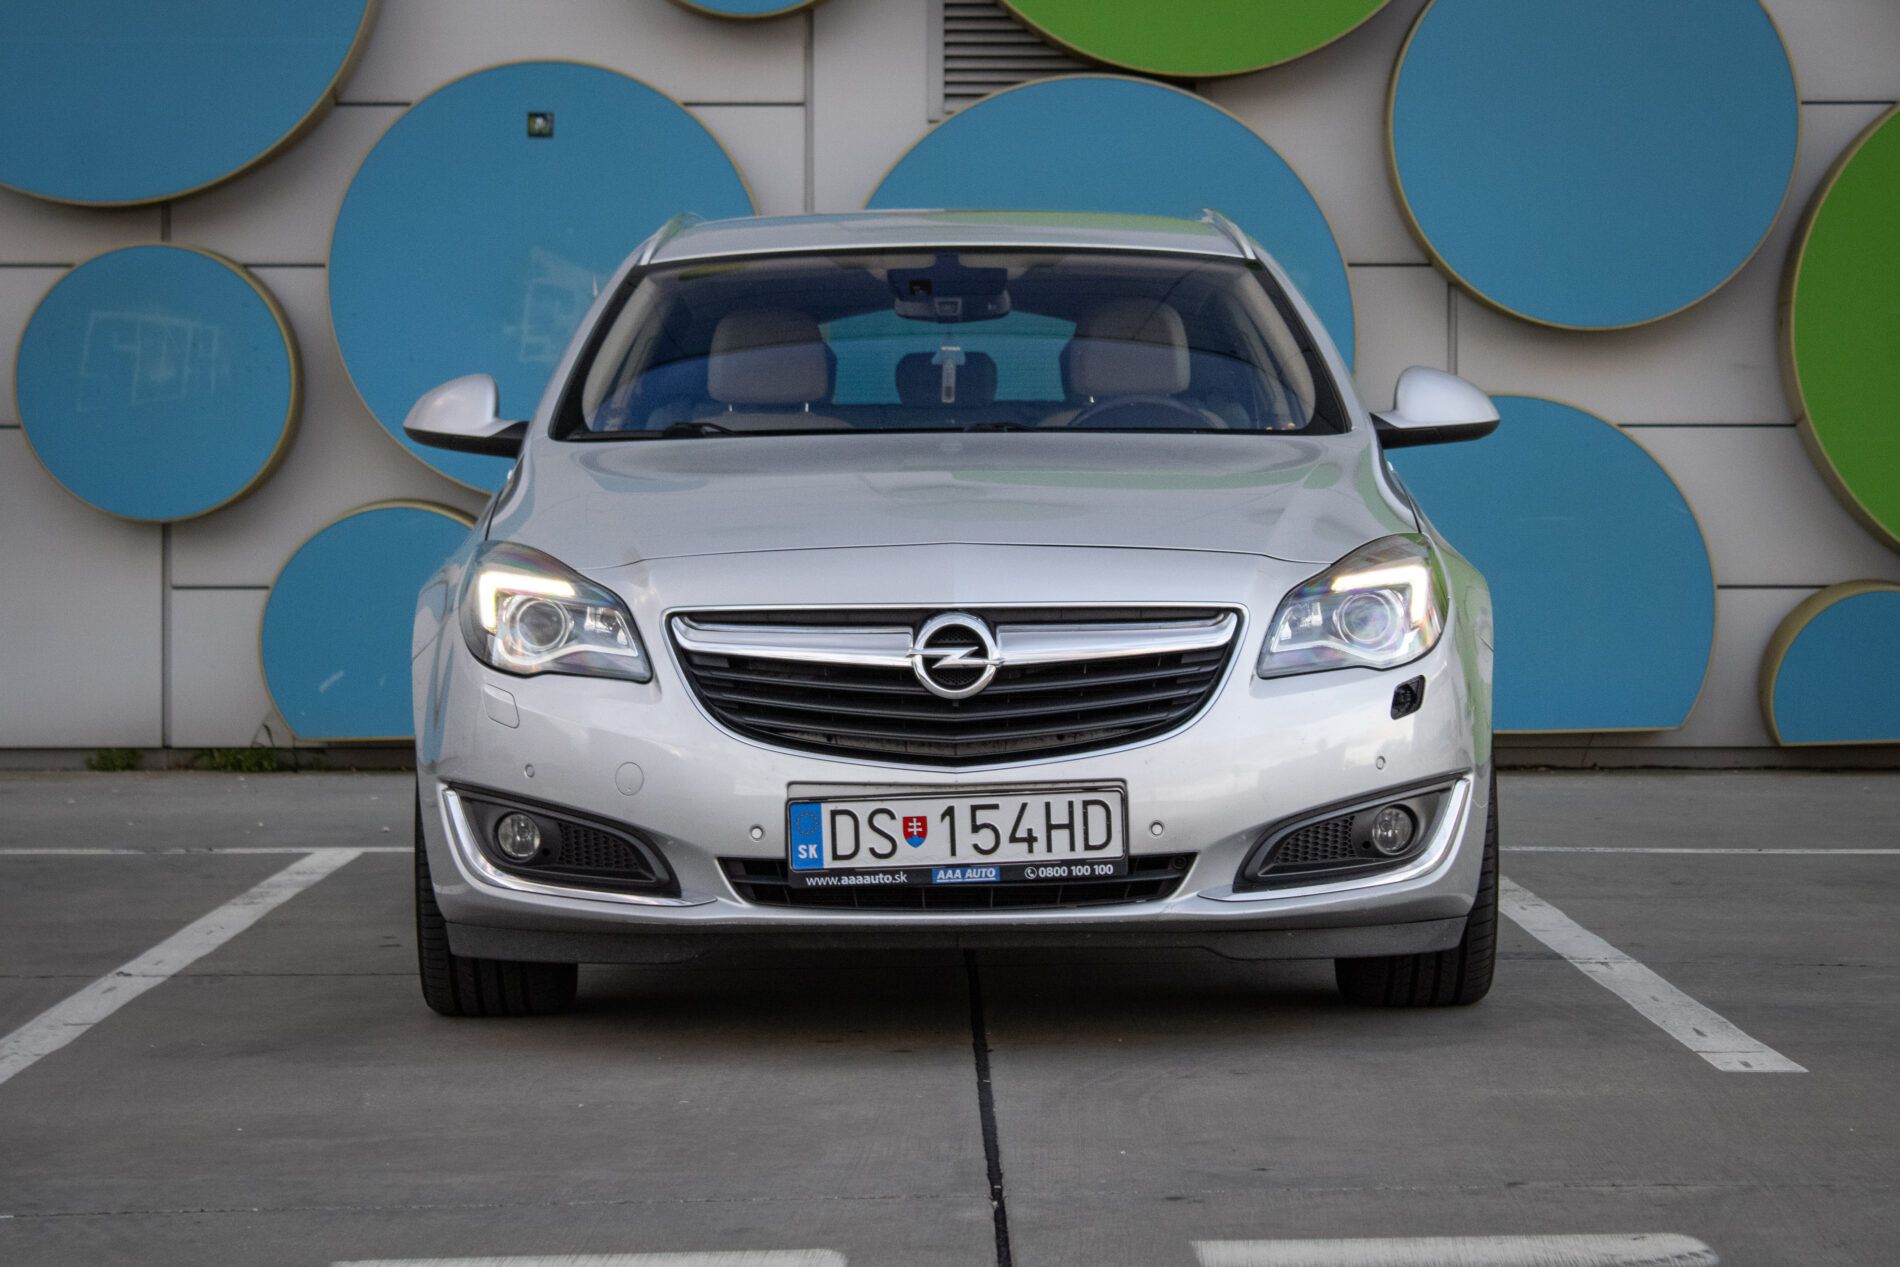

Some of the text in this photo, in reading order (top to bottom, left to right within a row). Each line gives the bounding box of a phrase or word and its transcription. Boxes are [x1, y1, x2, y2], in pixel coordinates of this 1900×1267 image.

[830, 799, 1112, 861] DS 154HD
[798, 844, 818, 859] SK
[936, 867, 996, 880] AAA AUTO
[1038, 864, 1114, 878] 0800 100 100
[806, 871, 908, 887] www.aaaauto.sk
